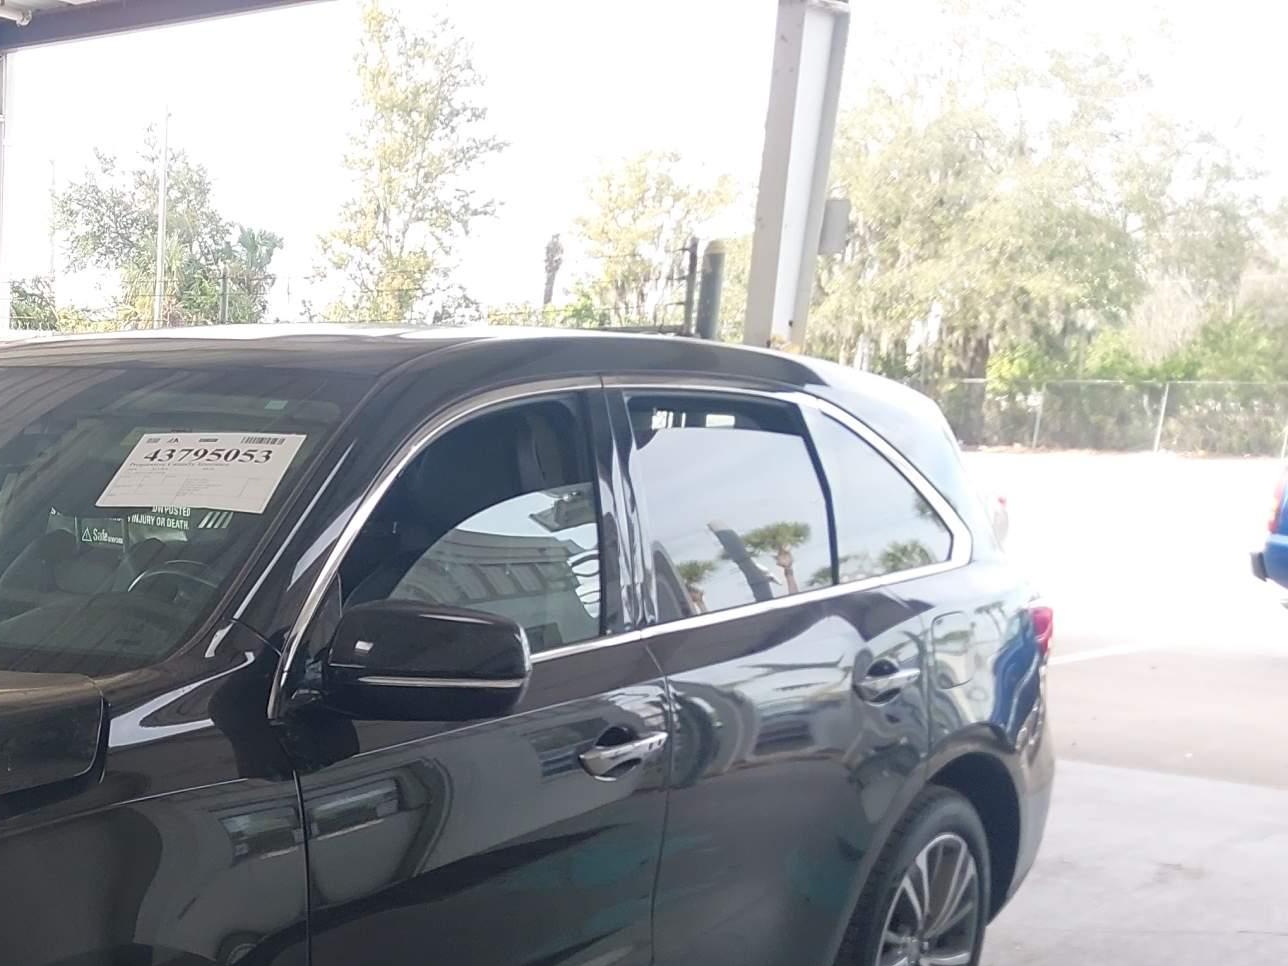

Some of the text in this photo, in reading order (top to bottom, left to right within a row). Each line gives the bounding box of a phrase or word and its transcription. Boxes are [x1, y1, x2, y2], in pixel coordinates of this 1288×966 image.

[143, 448, 273, 463] 43795053
[131, 514, 155, 526] INJURY
[156, 516, 166, 527] OR
